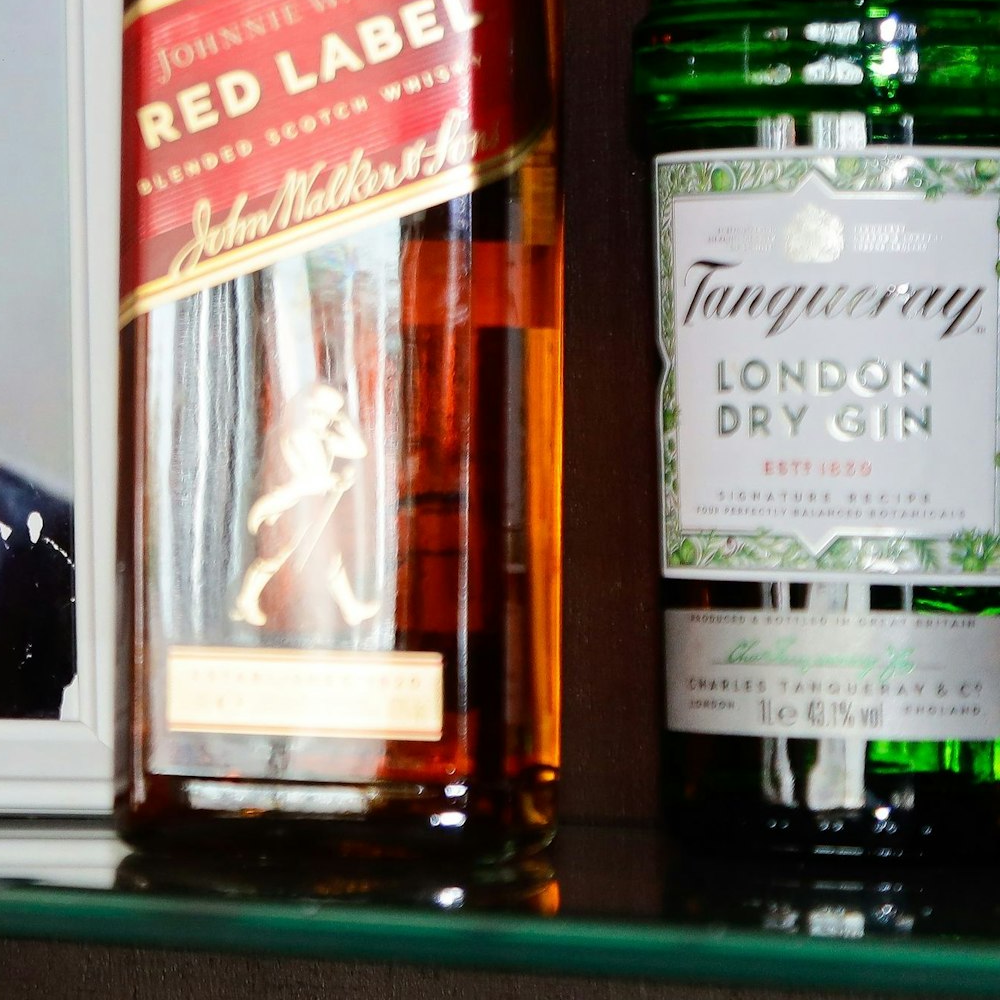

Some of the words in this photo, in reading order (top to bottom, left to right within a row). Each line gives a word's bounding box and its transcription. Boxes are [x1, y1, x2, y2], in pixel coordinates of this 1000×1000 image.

[156, 3, 302, 85] JOHNNIE
[136, 69, 262, 151] RED
[263, 95, 370, 147] SCOTCH
[379, 55, 482, 103] WHISY
[167, 191, 270, 279] John
[268, 147, 400, 230] Walker
[683, 259, 986, 340] Tanqueray
[717, 358, 932, 396] LONDON
[717, 403, 810, 437] DRY
[829, 403, 932, 440] GIN
[718, 491, 832, 504] SIGNATURE
[848, 493, 932, 506] RECIPE
[689, 677, 768, 694] CHARLES
[780, 679, 926, 697] TANQUERAY
